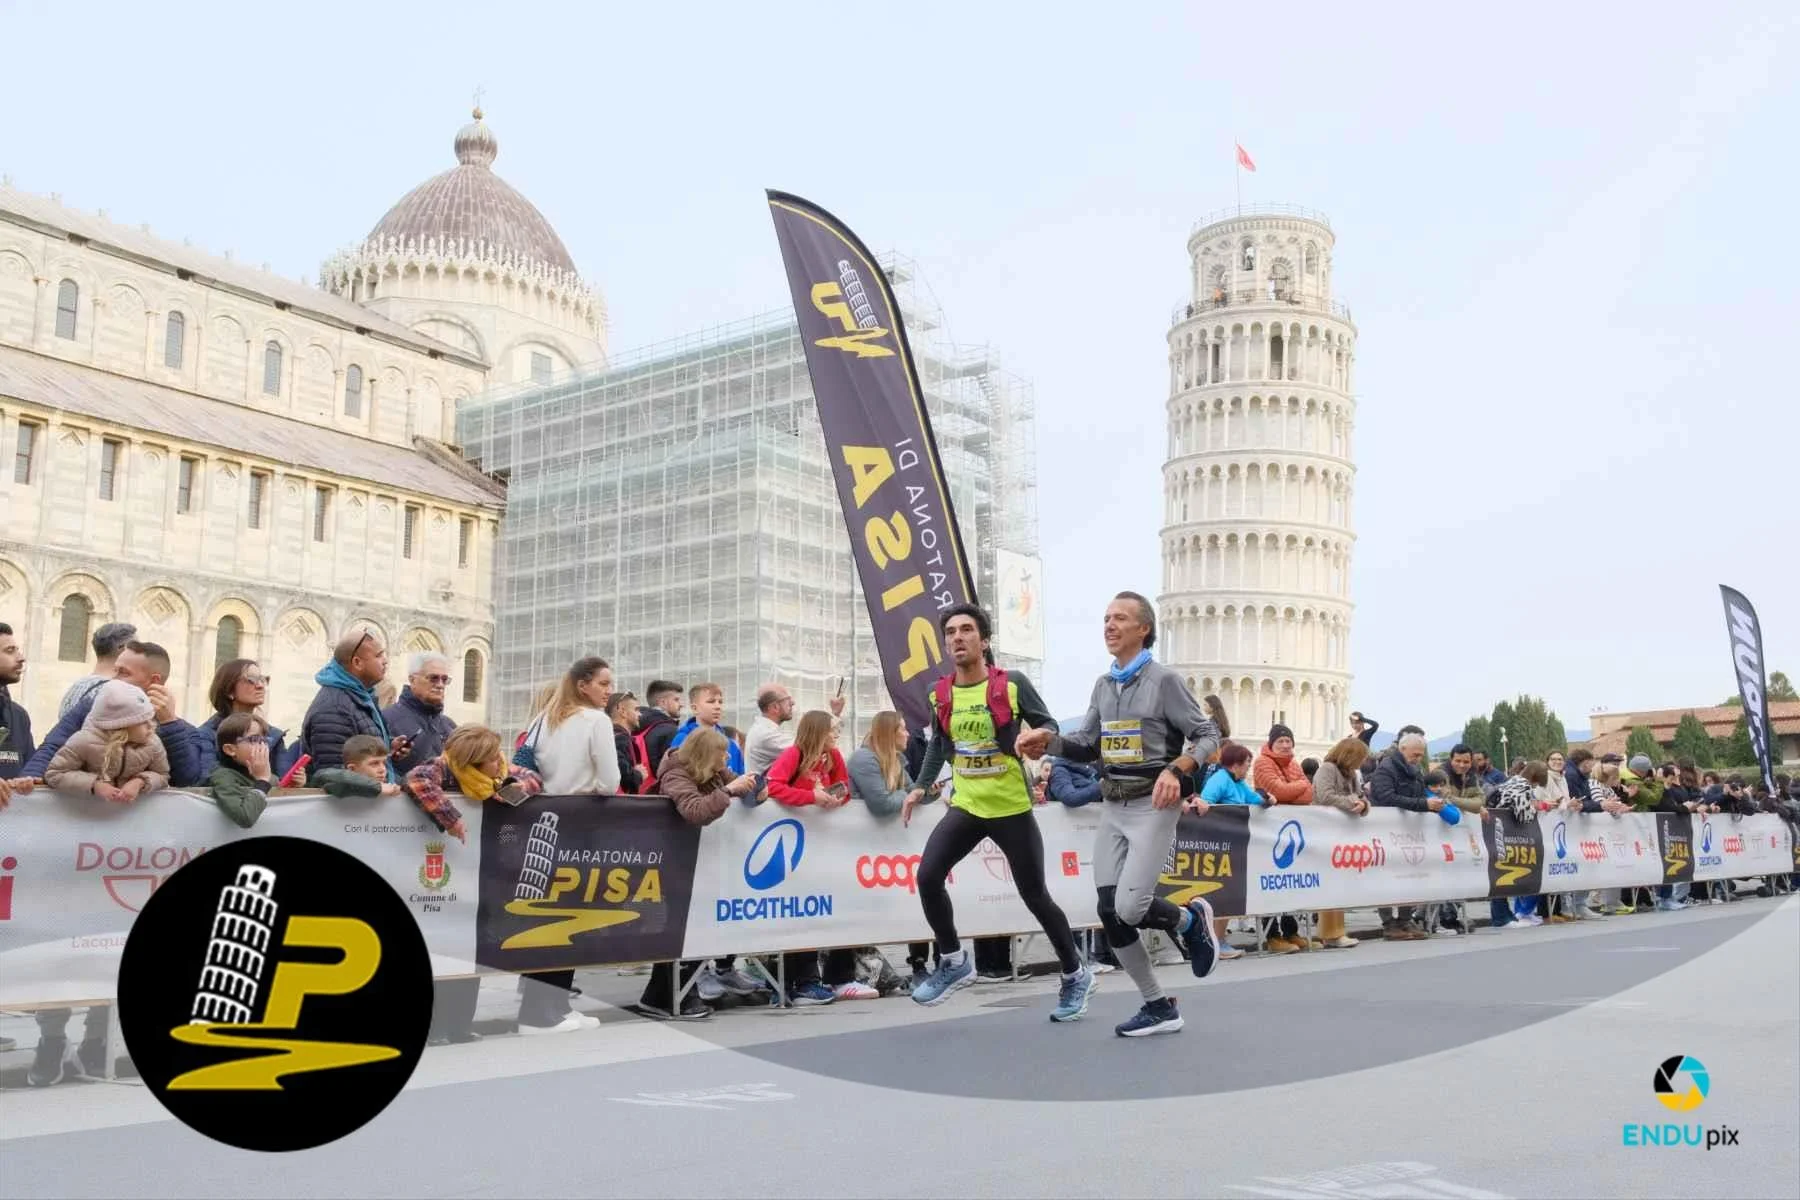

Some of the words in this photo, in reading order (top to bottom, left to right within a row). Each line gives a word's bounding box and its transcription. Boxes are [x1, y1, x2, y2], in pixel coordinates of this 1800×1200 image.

[1105, 736, 1130, 751] 752
[965, 756, 992, 769] 751
[1178, 840, 1219, 850] MARATONA
[559, 850, 641, 863] MARATONA
[648, 851, 662, 864] DI
[1332, 838, 1386, 872] coop.fi
[1504, 845, 1537, 865] PISA
[1176, 852, 1232, 877] PISA
[856, 854, 953, 894] coop
[1260, 873, 1320, 890] DECATHLON
[550, 868, 661, 903] PISA
[423, 904, 441, 913] Pisa
[716, 895, 832, 922] DECATHLON
